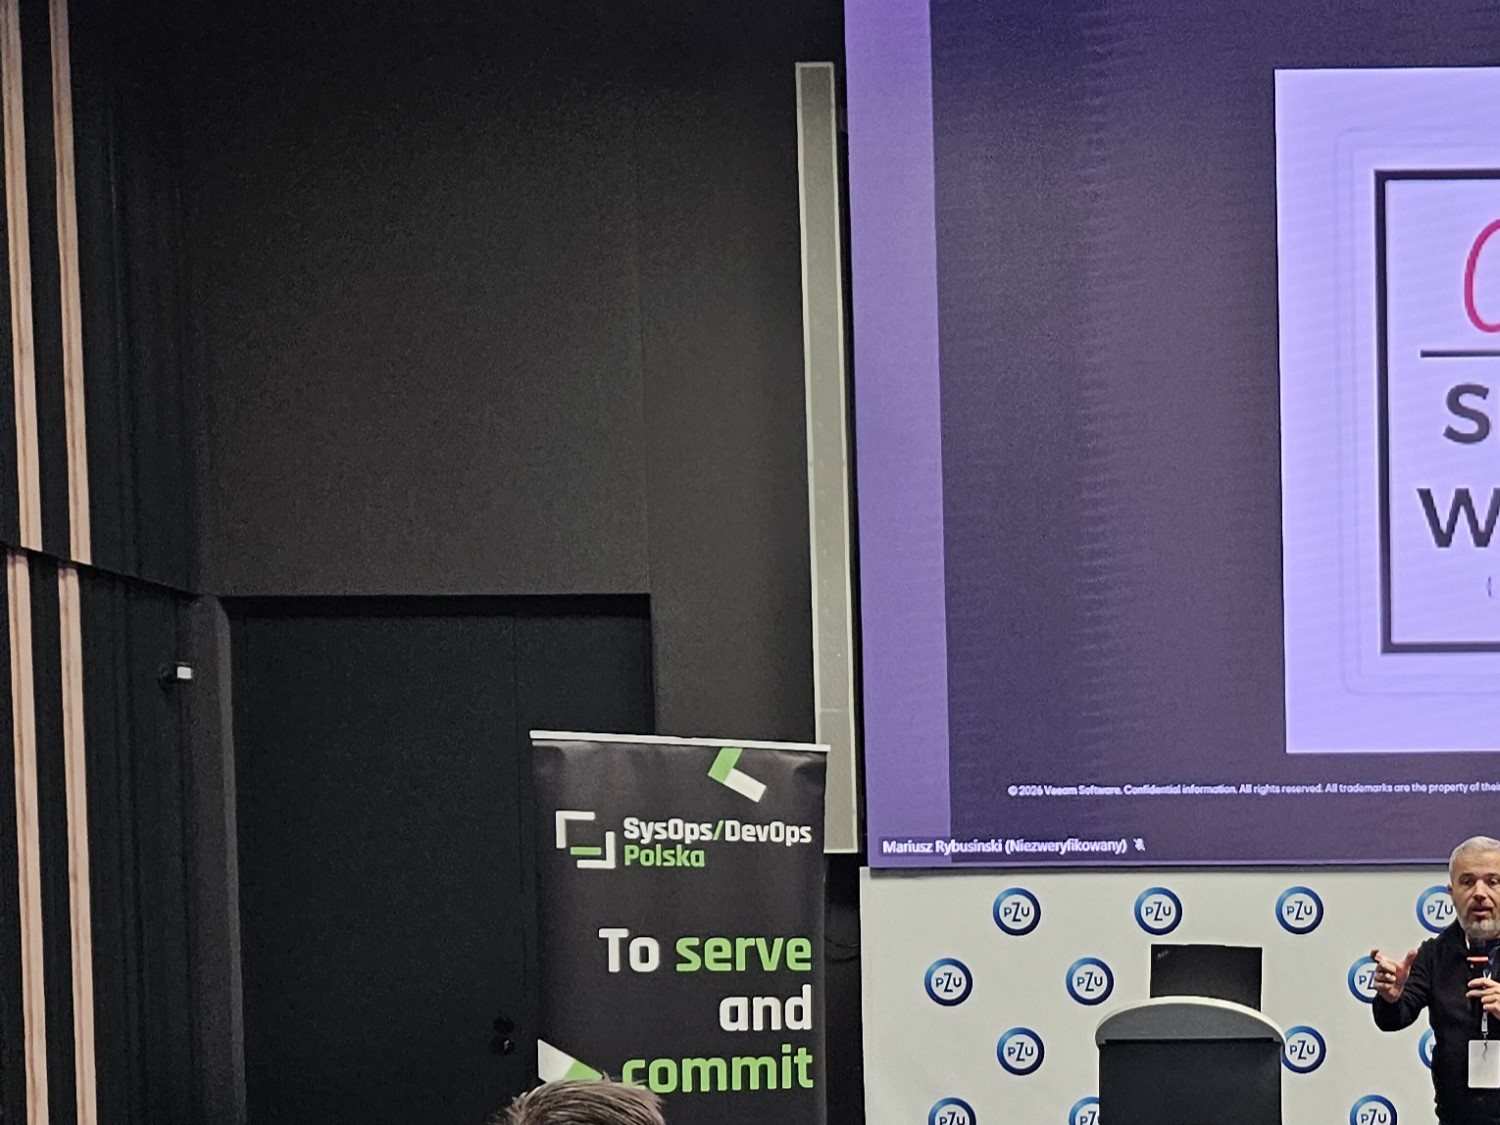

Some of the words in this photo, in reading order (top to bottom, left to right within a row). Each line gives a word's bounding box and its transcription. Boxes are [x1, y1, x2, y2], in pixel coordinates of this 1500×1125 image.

[1124, 785, 1181, 794] Confidential
[1239, 784, 1252, 793] All
[1254, 784, 1280, 795] rights
[1281, 783, 1323, 793] reserved.
[1325, 783, 1337, 792] All
[1339, 783, 1392, 792] trademarks
[1412, 783, 1427, 792] the
[1429, 783, 1468, 794] property
[1469, 782, 1479, 792] of
[624, 818, 812, 847] SysOps/DevOps
[625, 844, 705, 867] Polska
[883, 840, 933, 853] Mariusz
[1005, 839, 1127, 854] (Niezweryfikowany)
[1004, 902, 1029, 922] PZU
[1146, 902, 1171, 921] PZU
[1287, 901, 1312, 920] PZU
[599, 928, 660, 972] To
[676, 938, 811, 971] serve
[936, 973, 962, 992] PZU
[1077, 972, 1103, 991] PZU
[1359, 970, 1375, 990] PZ
[720, 984, 812, 1031] and
[1008, 1042, 1033, 1061] PZU
[1290, 1040, 1315, 1060] PZU
[622, 1043, 814, 1094] commit
